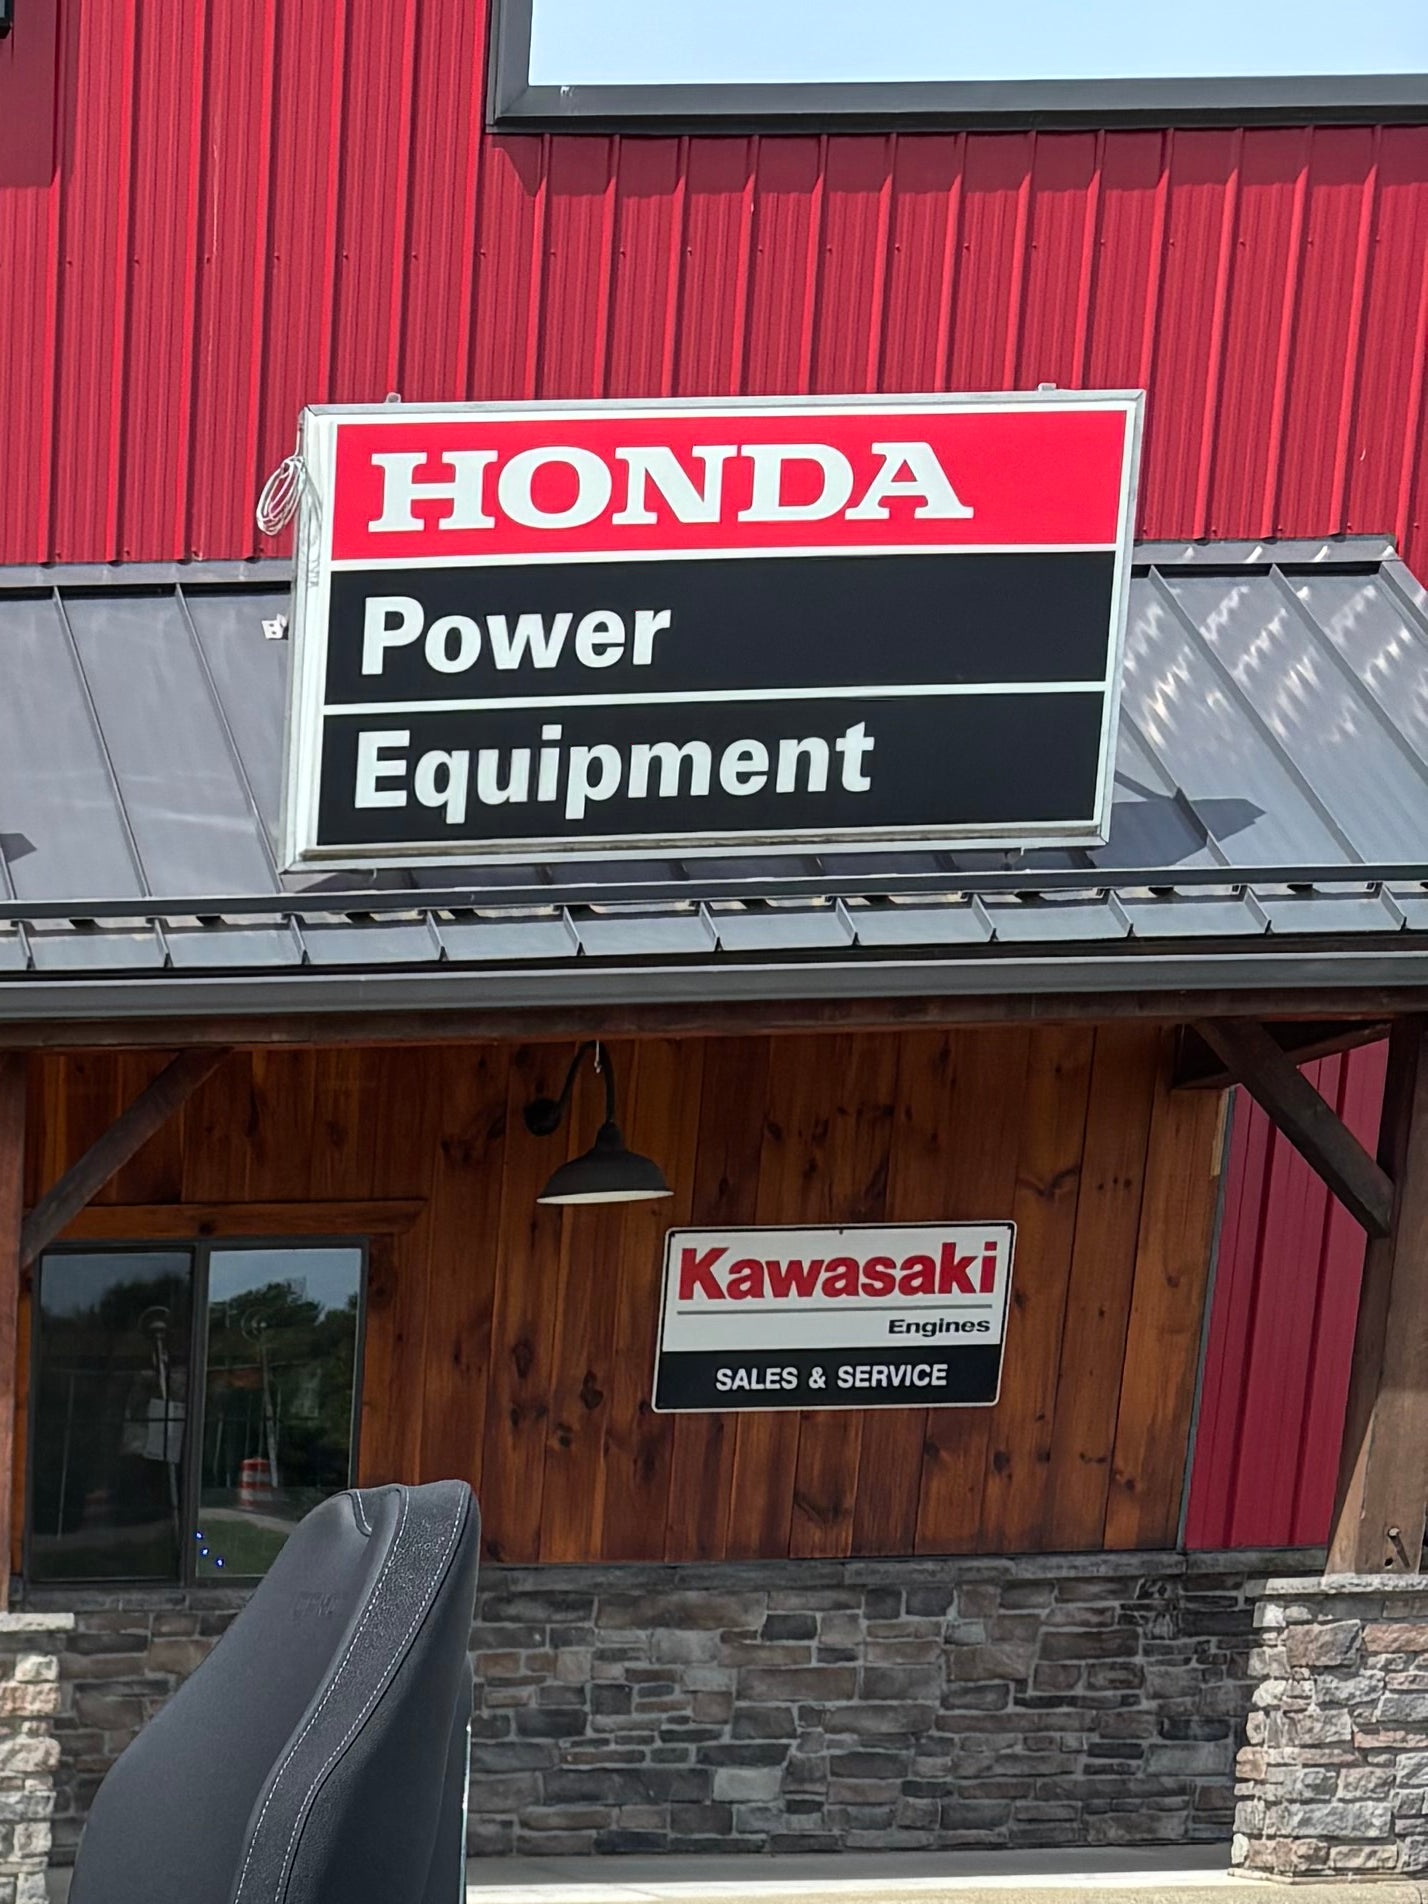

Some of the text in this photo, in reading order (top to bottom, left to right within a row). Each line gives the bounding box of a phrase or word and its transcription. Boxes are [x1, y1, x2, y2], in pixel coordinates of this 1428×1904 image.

[367, 441, 975, 533] HONDA
[361, 595, 672, 675] Power
[354, 721, 876, 825] Equipment
[677, 1241, 998, 1302] Kawasaki
[888, 1317, 991, 1338] Engines
[715, 1363, 949, 1392] SALES & SERVICE
